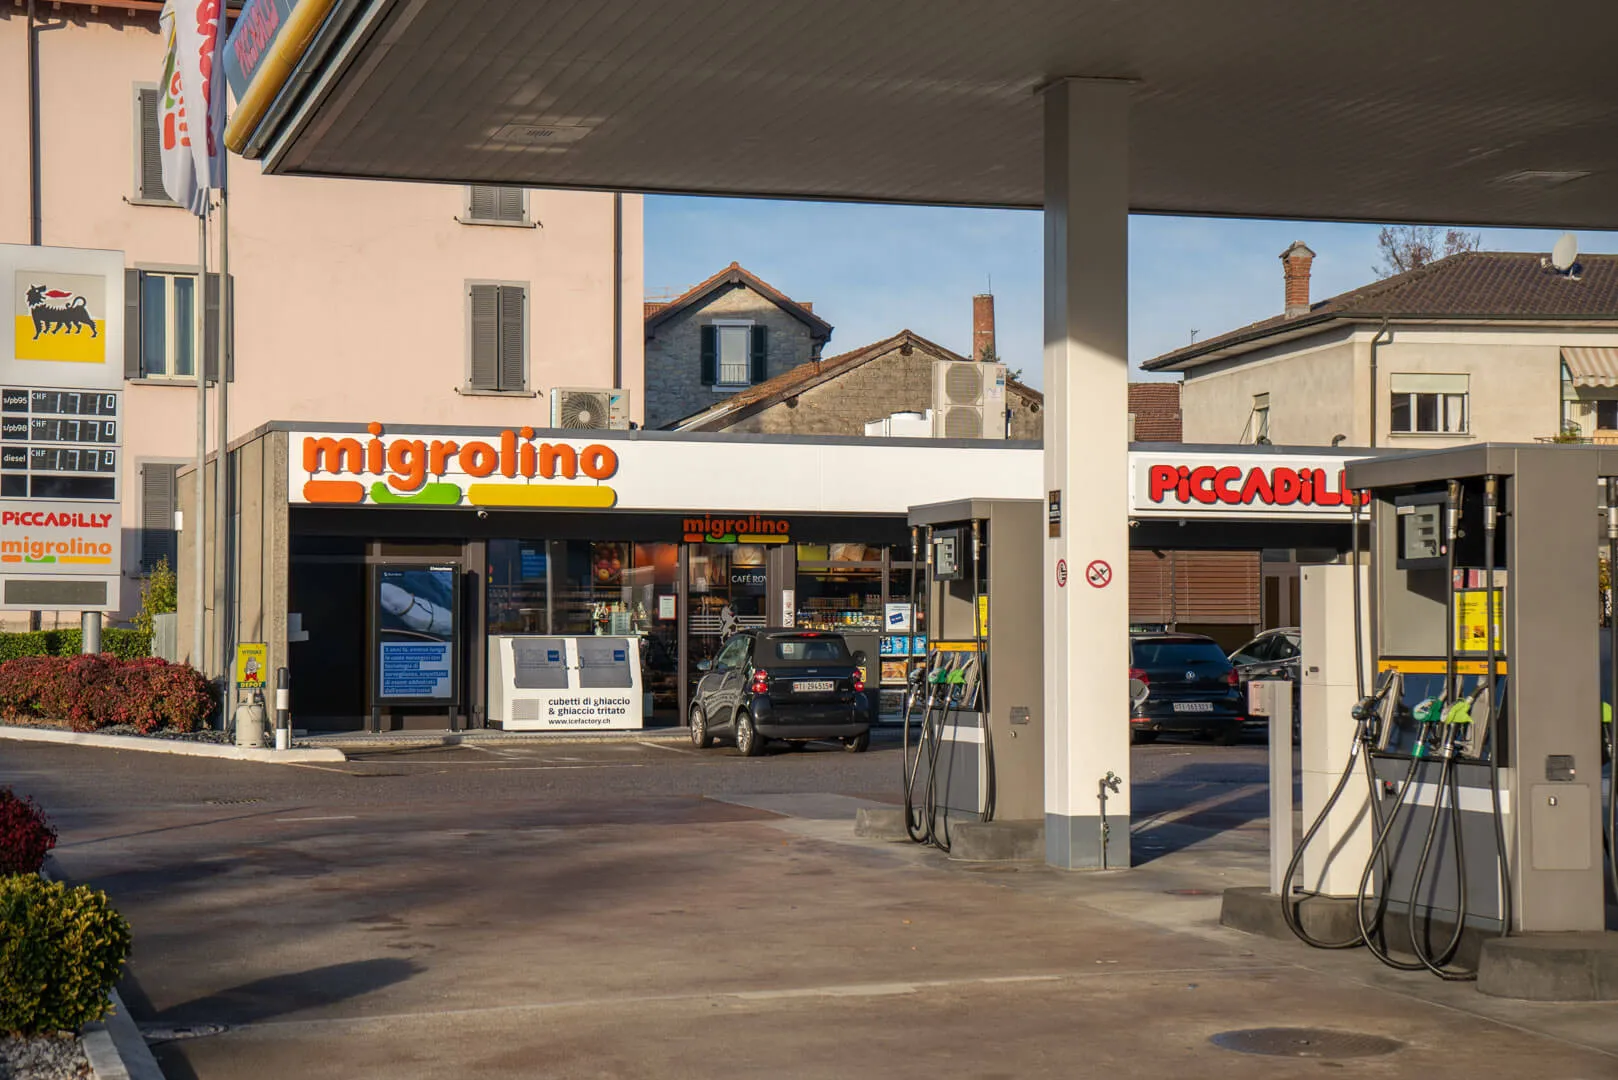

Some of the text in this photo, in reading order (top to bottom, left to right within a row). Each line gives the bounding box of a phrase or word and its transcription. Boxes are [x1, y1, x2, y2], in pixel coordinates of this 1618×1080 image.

[32, 392, 47, 400] CHF
[31, 420, 47, 428] CHF
[3, 453, 26, 462] diesel
[31, 449, 46, 457] CHF
[303, 421, 617, 491] migrolino
[683, 513, 790, 538] migrolino
[1, 536, 112, 559] migrolino
[731, 574, 751, 583] CAFÉ
[548, 697, 630, 706] cubetti di ghiaccio
[548, 707, 555, 715] &
[558, 707, 595, 716] ghiaccio
